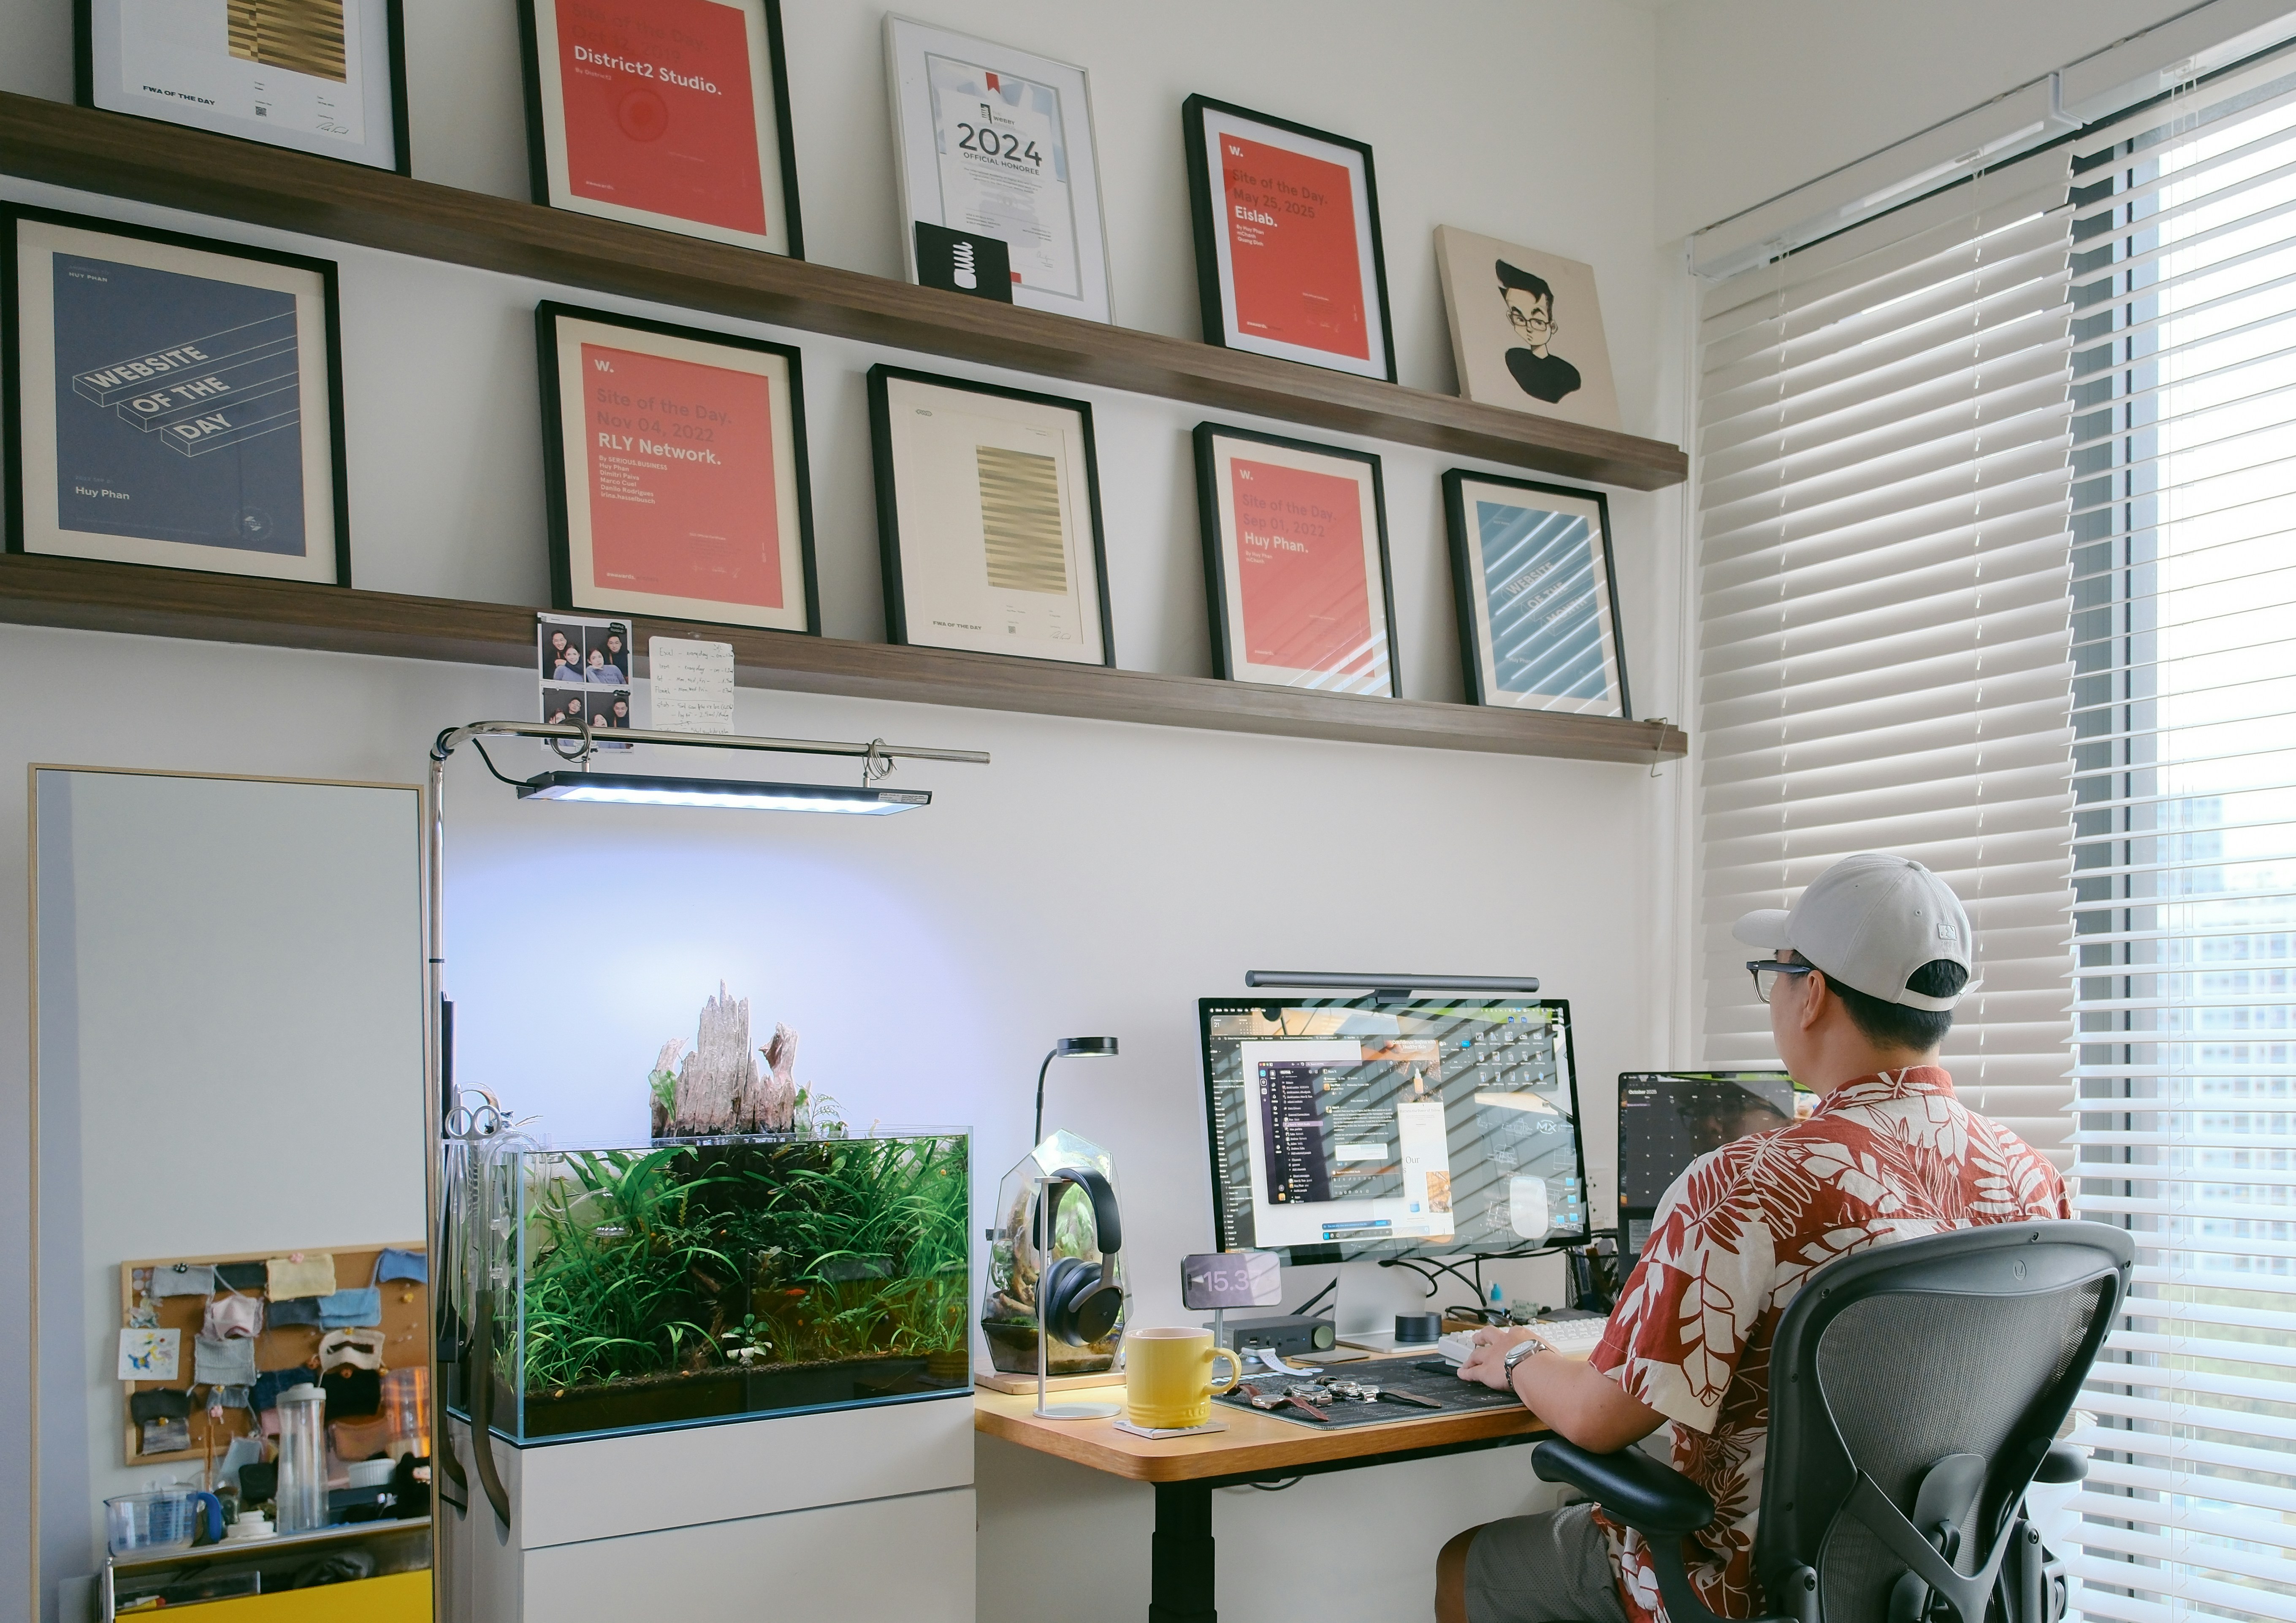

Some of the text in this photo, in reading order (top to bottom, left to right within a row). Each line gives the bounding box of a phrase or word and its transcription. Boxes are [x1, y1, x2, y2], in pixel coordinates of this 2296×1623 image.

[575, 45, 722, 96] District2 Studio.
[143, 85, 163, 95] FWA
[178, 92, 196, 102] THE
[197, 97, 216, 106] DAY
[957, 123, 1042, 167] 2024
[963, 152, 1040, 176] OFFICIAL HONOREE
[1233, 169, 1328, 206] Site of the Day.
[1233, 188, 1316, 219] May 25, 2025
[1235, 205, 1278, 228] Eislab.
[87, 274, 108, 282] PHAN
[84, 345, 209, 388] WEBSITE
[132, 377, 231, 413] OF THE
[597, 388, 732, 426] Site of the Day.
[173, 413, 233, 439] DAY
[597, 411, 715, 442] Nov 04, 2022
[599, 432, 721, 466] RLY Network.
[599, 470, 640, 481] Dimitri Paiva
[609, 457, 668, 471] SERIOUS.BUSINESS
[76, 486, 130, 500] Huy Phan
[600, 477, 621, 485] Marco
[601, 484, 654, 497] Danilo Rodrigues
[1242, 494, 1337, 523] Site of the Day.
[1243, 513, 1325, 537] Sep 01, 2022
[1244, 531, 1309, 553] Huy Phan.
[1537, 1121, 1557, 1133] MX
[1405, 1156, 1420, 1164] Our
